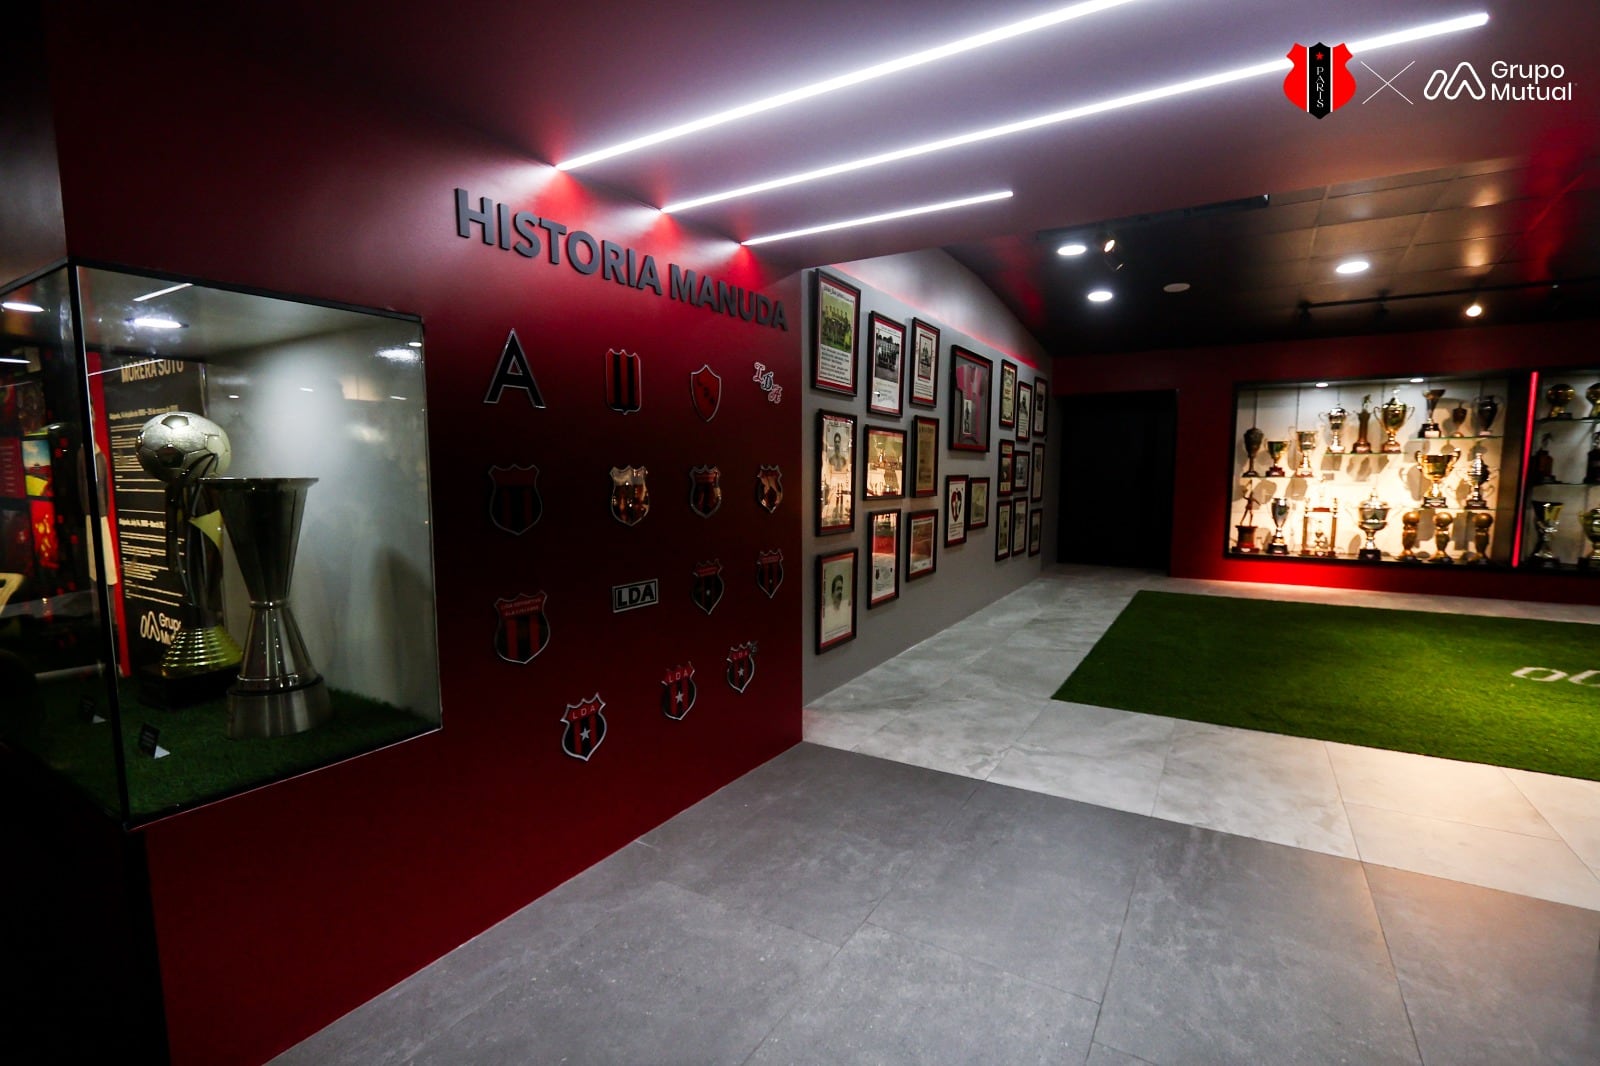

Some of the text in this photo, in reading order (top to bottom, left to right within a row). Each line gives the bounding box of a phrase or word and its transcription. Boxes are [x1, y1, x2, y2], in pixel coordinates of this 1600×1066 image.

[454, 187, 789, 331] HISTORIA MANUDA
[483, 327, 547, 409] A
[617, 584, 655, 608] LDA
[158, 612, 182, 635] Grup
[667, 669, 689, 683] LDA
[571, 705, 596, 720] LDA
